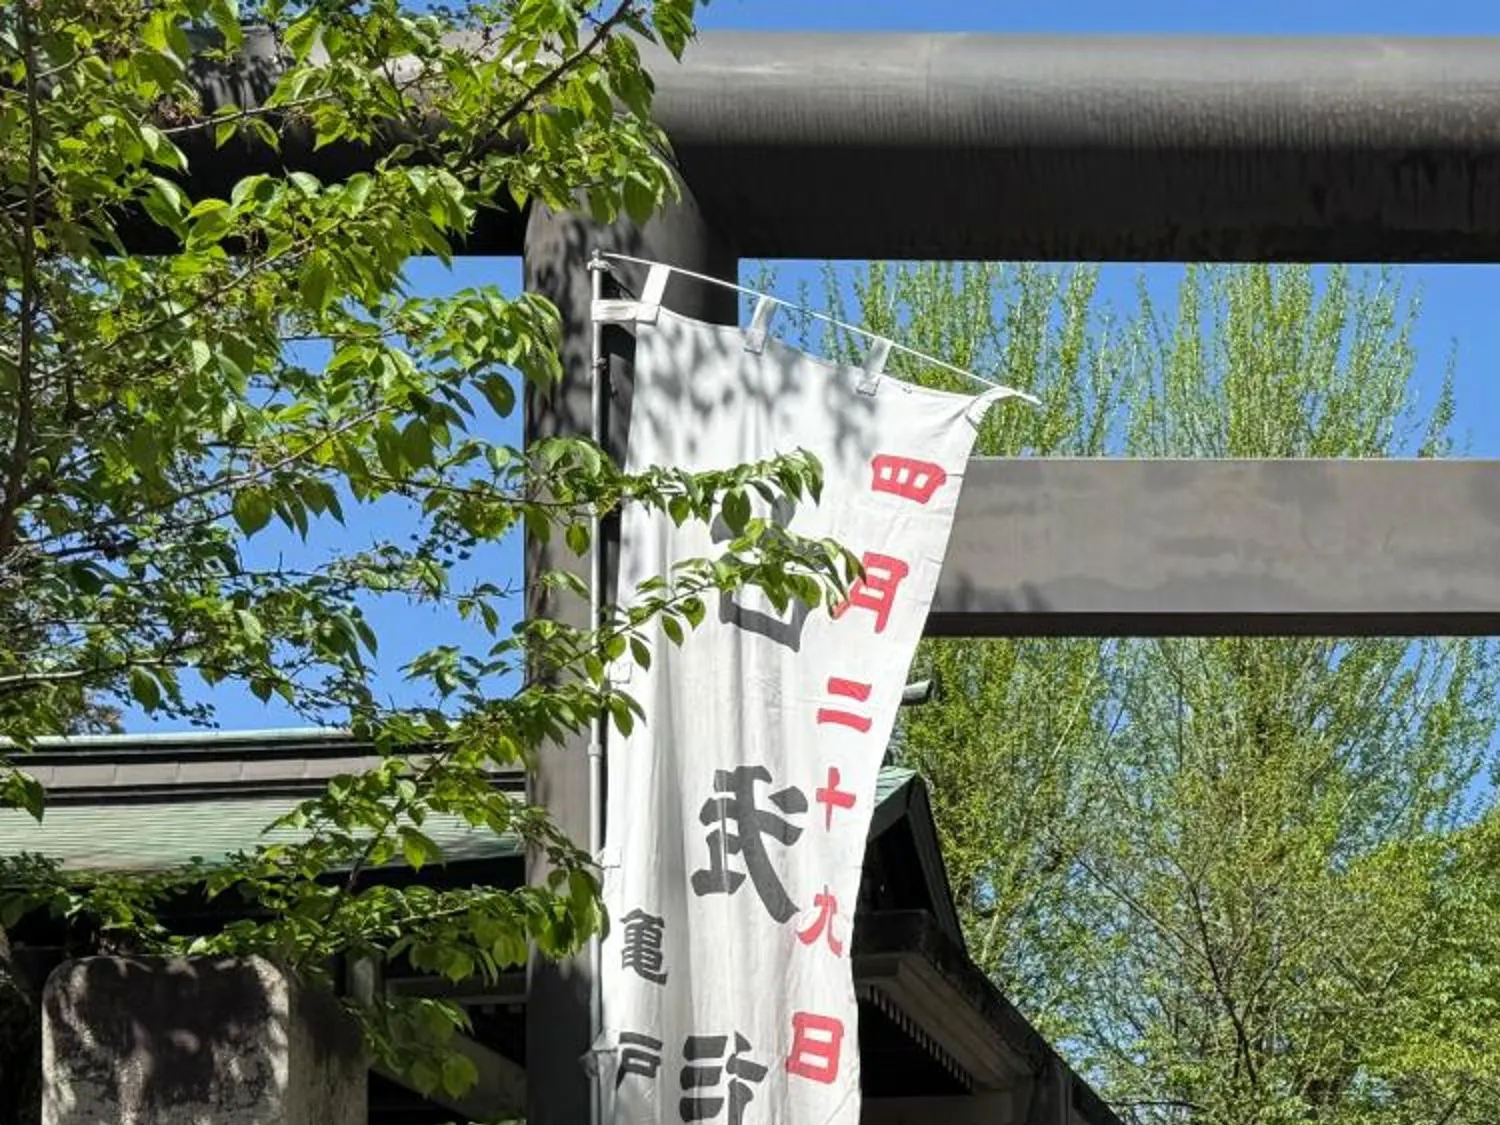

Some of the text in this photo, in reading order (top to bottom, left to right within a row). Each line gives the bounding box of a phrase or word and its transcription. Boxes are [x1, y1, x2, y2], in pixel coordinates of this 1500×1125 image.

[786, 453, 947, 1084] 四月二十九日
